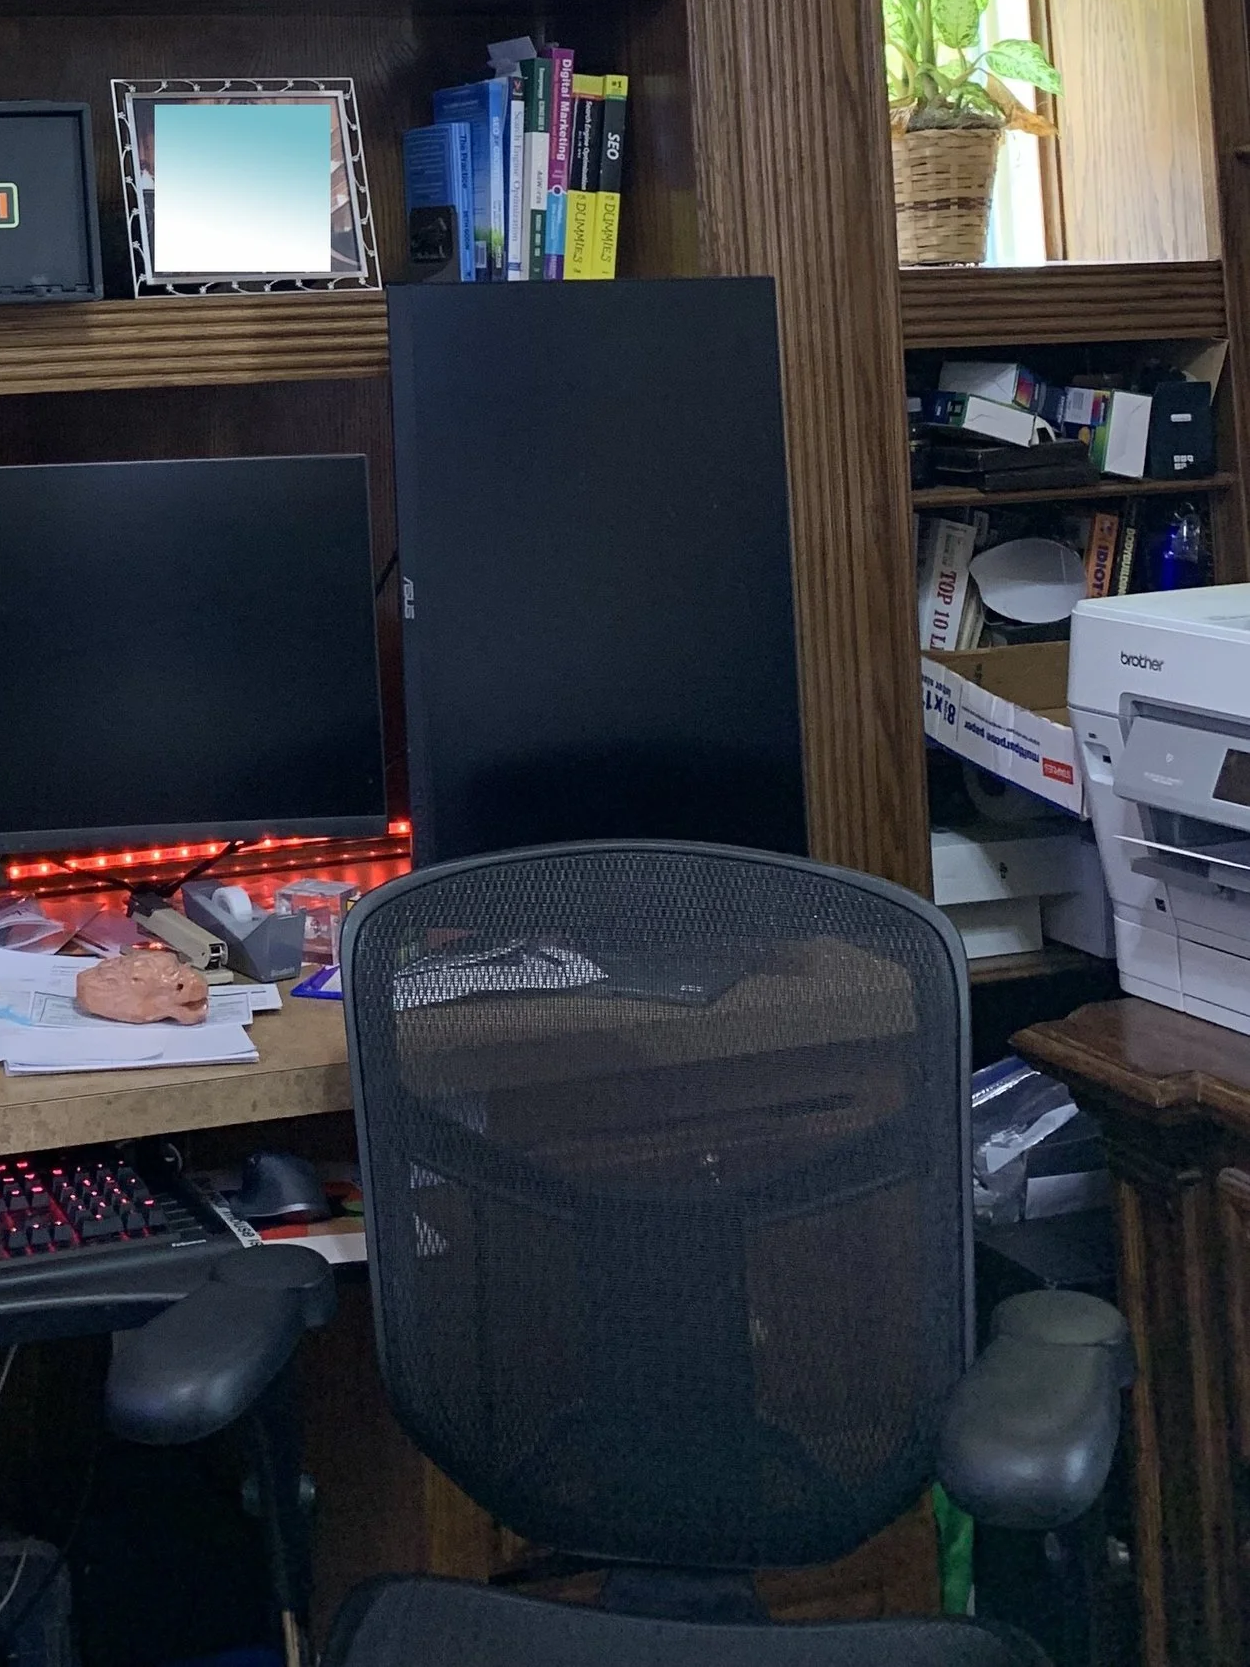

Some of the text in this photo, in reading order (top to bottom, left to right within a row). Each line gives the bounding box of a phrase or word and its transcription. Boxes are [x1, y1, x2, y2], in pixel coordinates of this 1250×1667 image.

[555, 59, 571, 161] Digital Marketing
[607, 132, 620, 160] SEO
[573, 202, 586, 263] DUMMIES
[601, 203, 616, 263] DUMMIES
[933, 570, 957, 630] TOP 10
[1120, 651, 1164, 671] brother
[964, 720, 985, 738] paper
[986, 732, 1040, 763] multipurpose
